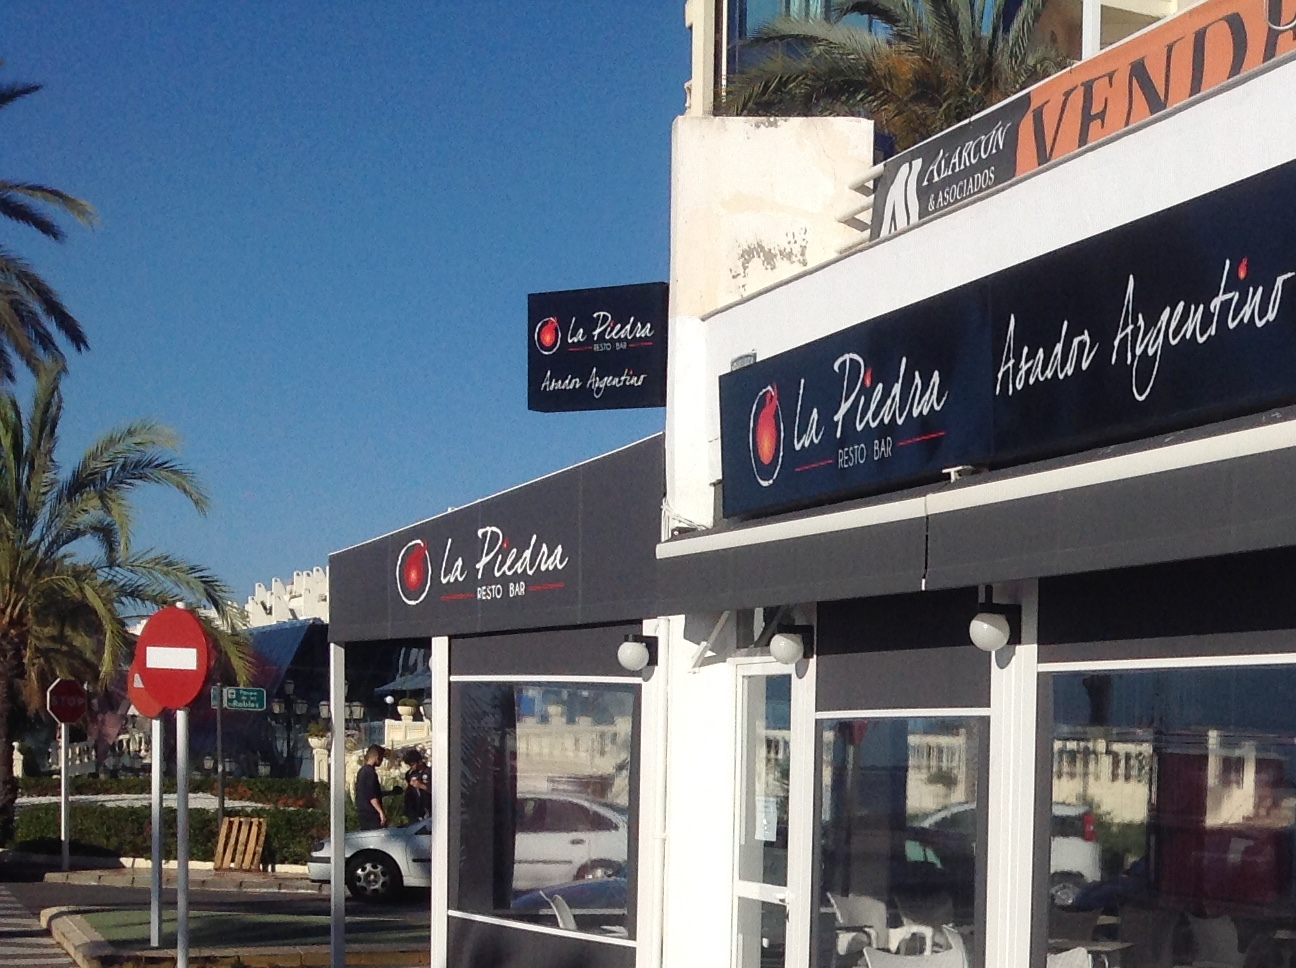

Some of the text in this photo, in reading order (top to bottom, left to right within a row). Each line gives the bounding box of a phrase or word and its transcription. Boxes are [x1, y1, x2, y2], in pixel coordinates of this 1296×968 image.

[922, 121, 1012, 186] ALARCÓN
[928, 166, 995, 212] & ASOCIADOS
[567, 311, 654, 344] La Piedra
[996, 258, 1295, 401] Asador Argentino
[593, 341, 627, 352] RESTO BAR
[541, 367, 647, 399] Asador Argentino
[794, 352, 949, 451] La Piedra
[838, 436, 893, 470] RESTO BAR
[440, 526, 569, 584] La Piedra
[477, 581, 526, 600] RESTO BAR
[51, 695, 84, 707] STOP
